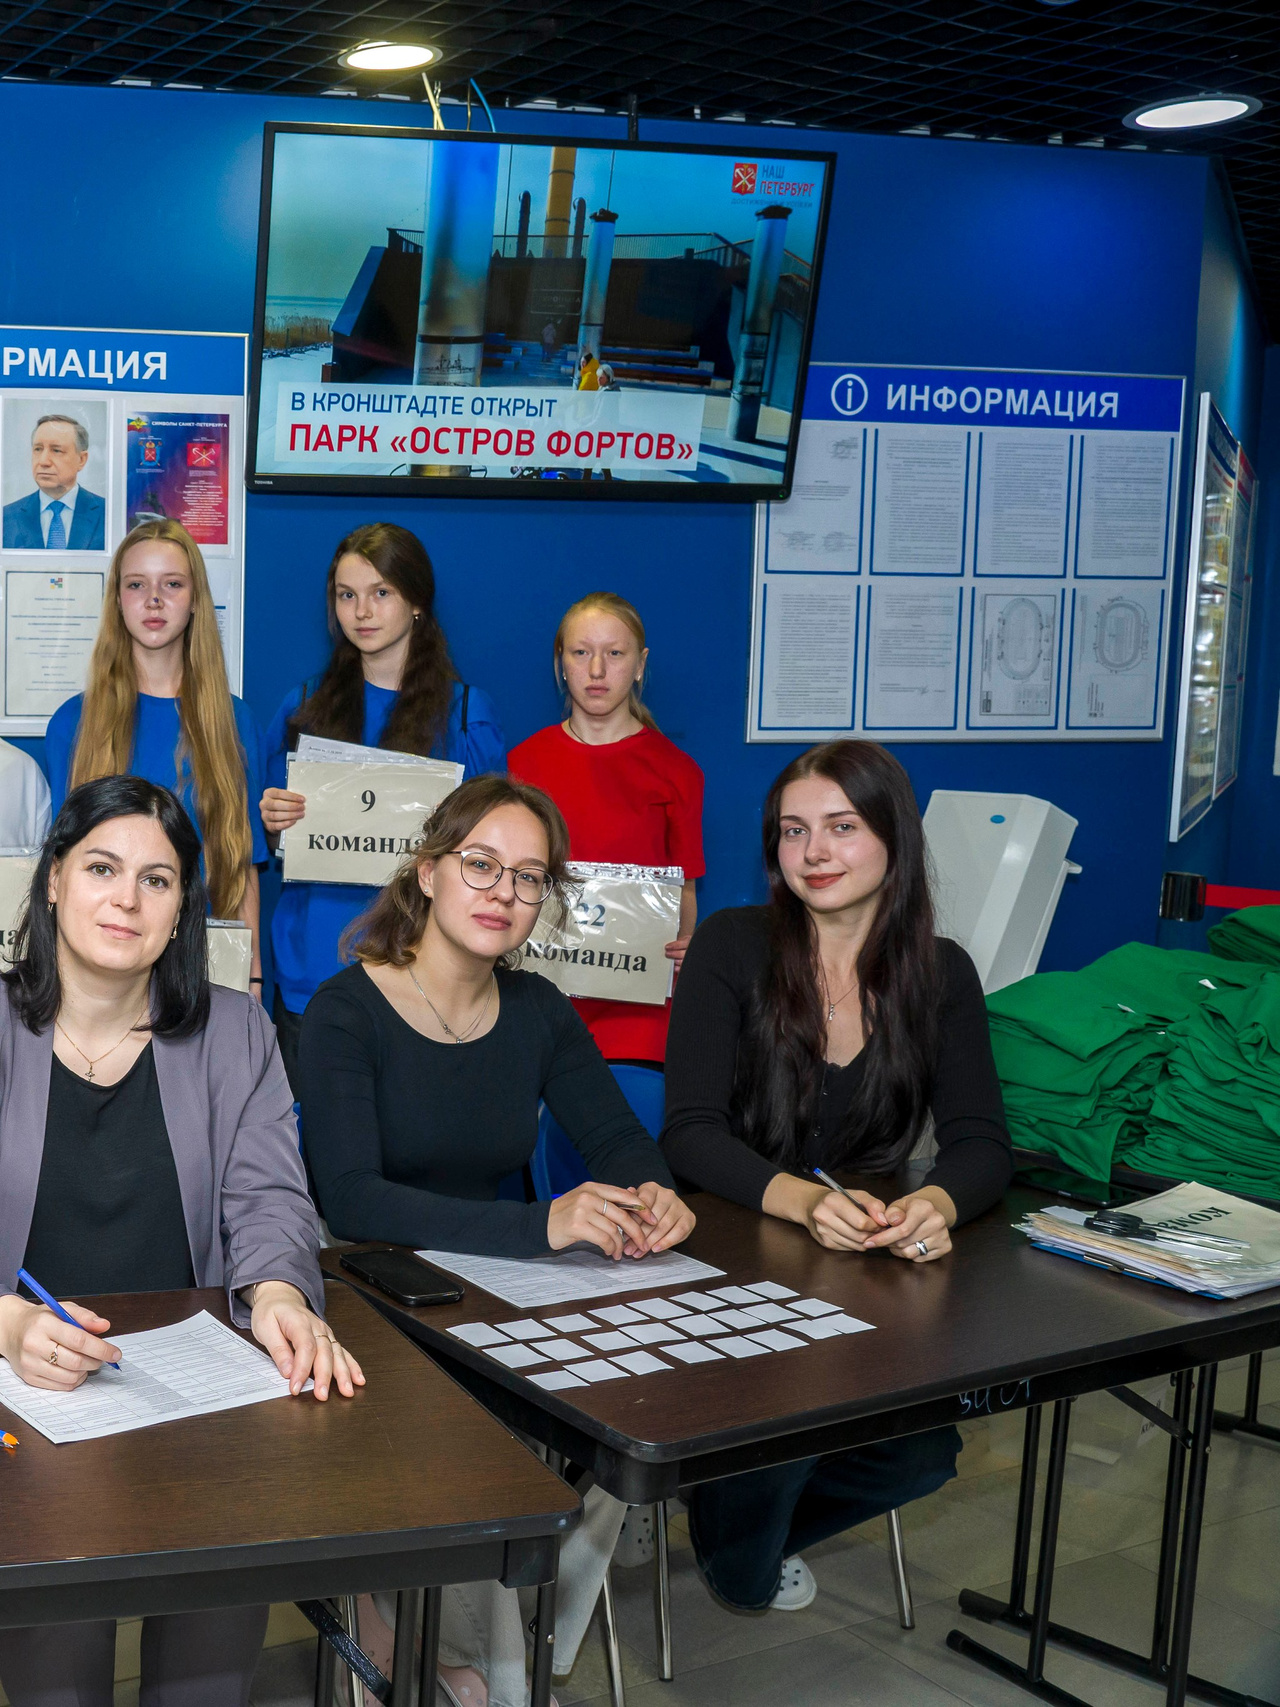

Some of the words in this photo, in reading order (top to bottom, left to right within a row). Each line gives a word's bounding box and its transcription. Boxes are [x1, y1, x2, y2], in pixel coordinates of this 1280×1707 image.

[762, 165, 785, 178] НАШ
[760, 181, 814, 196] ПЕТЕРБУРГ
[291, 392, 305, 411] В
[312, 393, 465, 418] КРОНШТАДТЕ
[470, 397, 558, 418] ОТКРЫТ
[887, 384, 1119, 421] ИНФОРМАЦИЯ
[289, 424, 380, 452] ПАРК
[390, 426, 535, 457] «ОСТРОВ
[546, 430, 694, 460] ФОРТОВ»
[361, 790, 376, 812] 9
[574, 902, 606, 927] 22
[524, 942, 647, 973] команда
